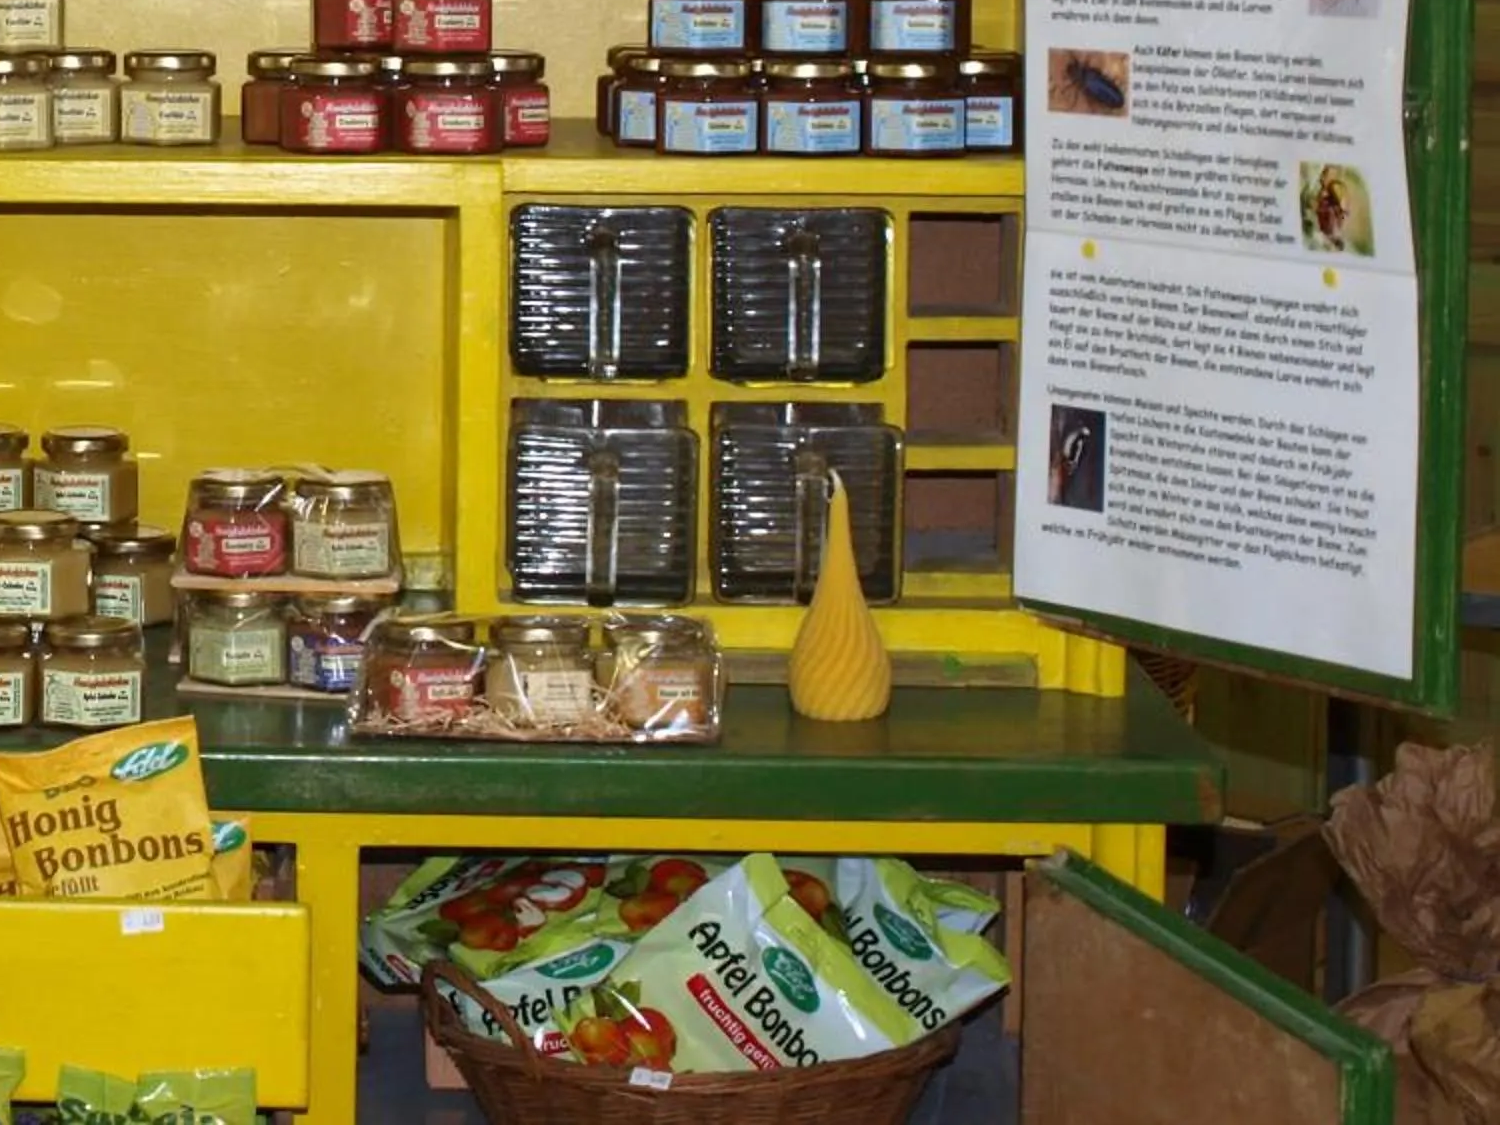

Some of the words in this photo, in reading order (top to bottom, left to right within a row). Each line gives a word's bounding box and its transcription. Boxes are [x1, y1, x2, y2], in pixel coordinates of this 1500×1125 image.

[7, 794, 122, 849] Honig
[33, 830, 204, 880] Bonbons
[689, 921, 755, 999] Apfel
[744, 986, 819, 1067] Bonbo
[852, 928, 947, 1030] Bonbons
